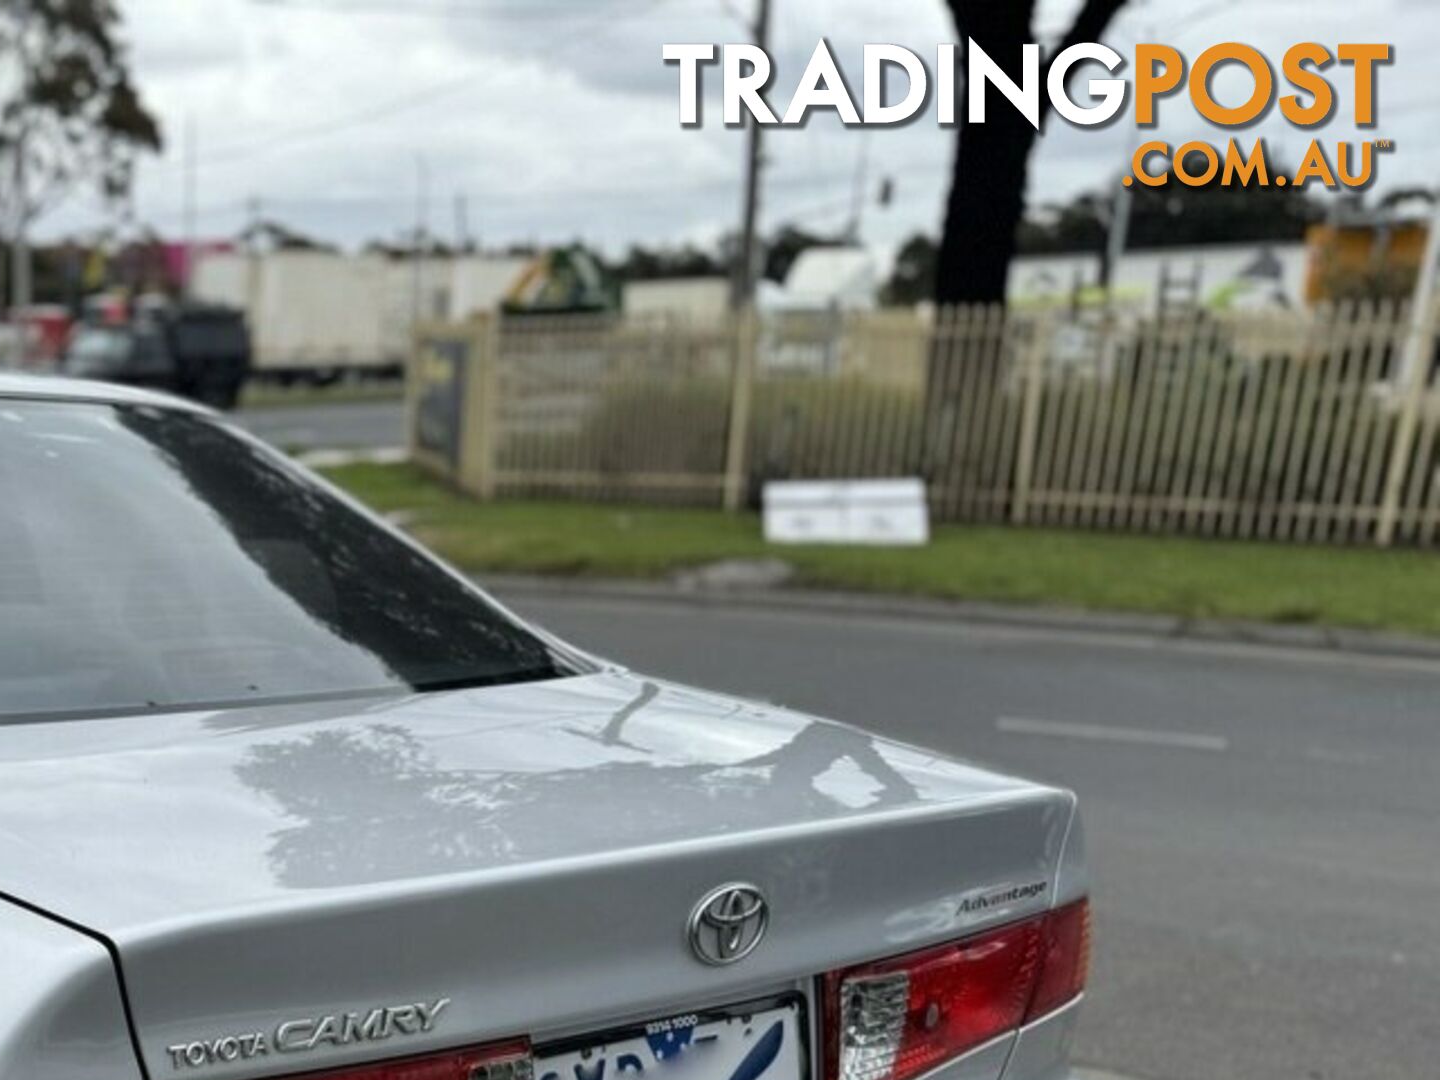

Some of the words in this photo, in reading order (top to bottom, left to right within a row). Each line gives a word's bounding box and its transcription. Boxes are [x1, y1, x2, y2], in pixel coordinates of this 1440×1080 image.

[955, 881, 1048, 917] Advantage
[167, 1031, 268, 1069] TOYOTA
[272, 998, 451, 1053] CAMRY
